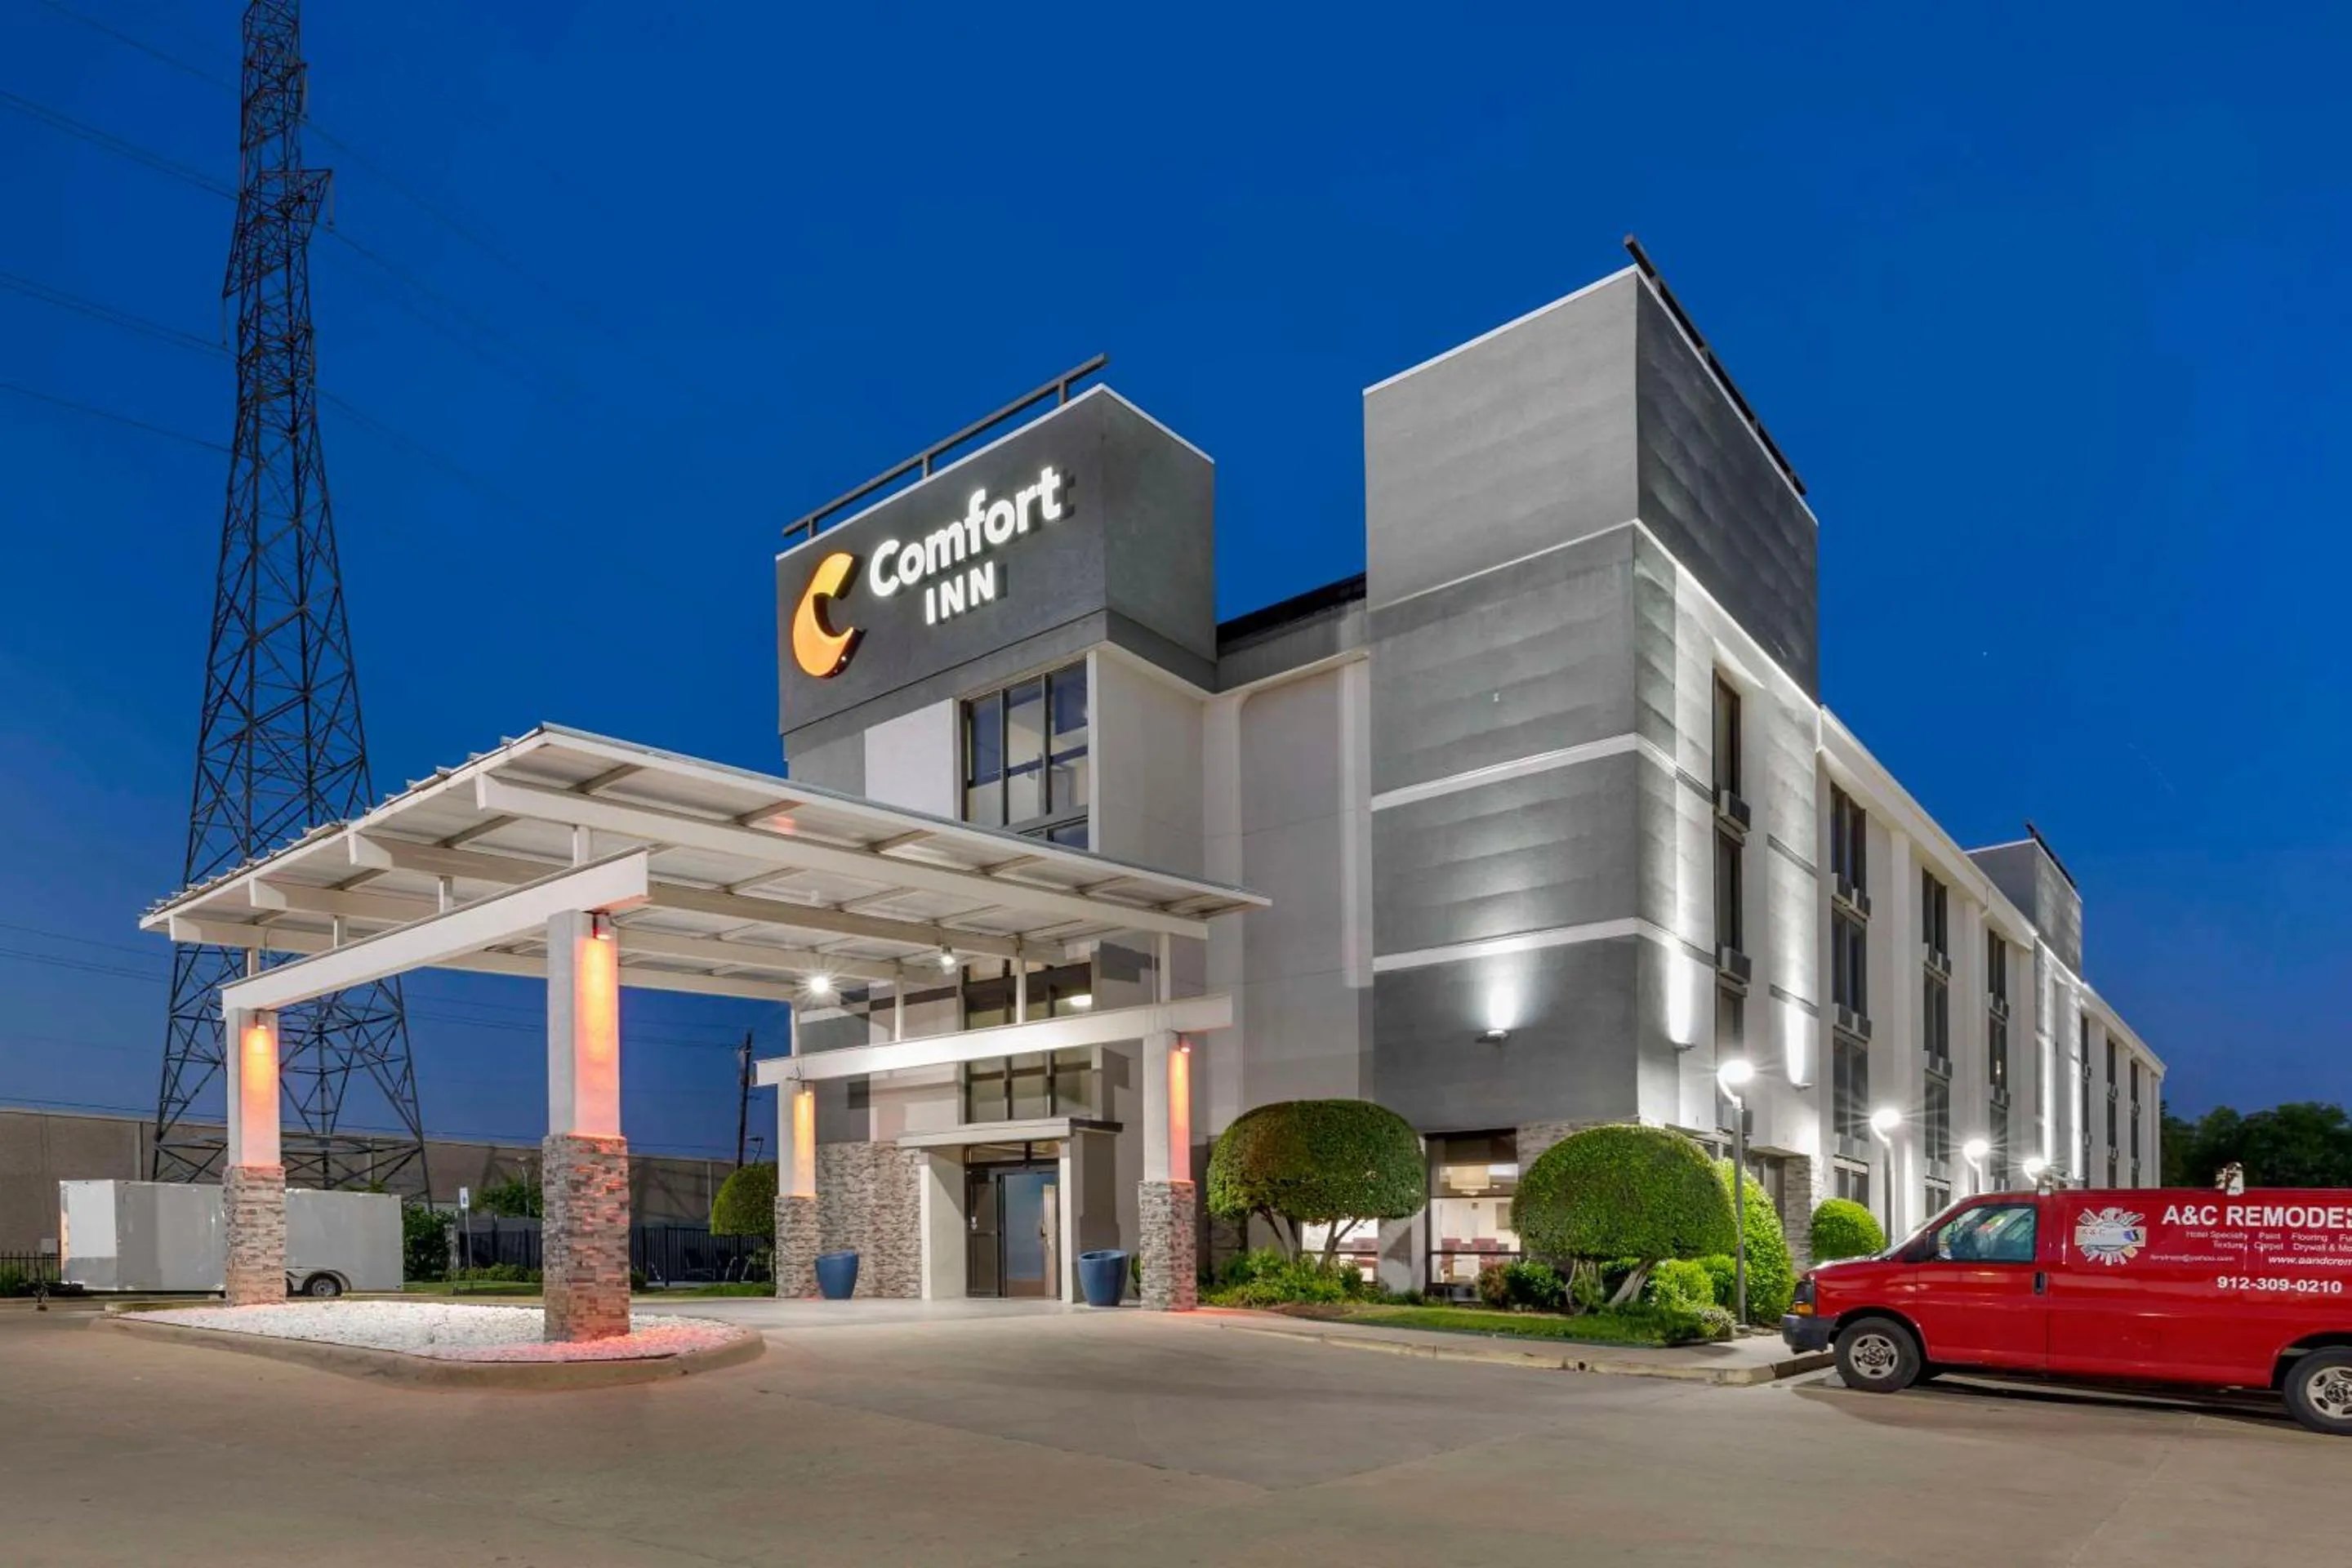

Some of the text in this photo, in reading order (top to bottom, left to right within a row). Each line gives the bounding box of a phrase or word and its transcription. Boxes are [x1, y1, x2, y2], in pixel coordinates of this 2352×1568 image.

[869, 466, 1062, 598] Comfort
[925, 561, 996, 626] INN
[2162, 1205, 2218, 1226] A&C
[2259, 1232, 2281, 1241] Paint
[2291, 1232, 2328, 1243] Flooring
[2216, 1276, 2342, 1294] 912-309-0210
